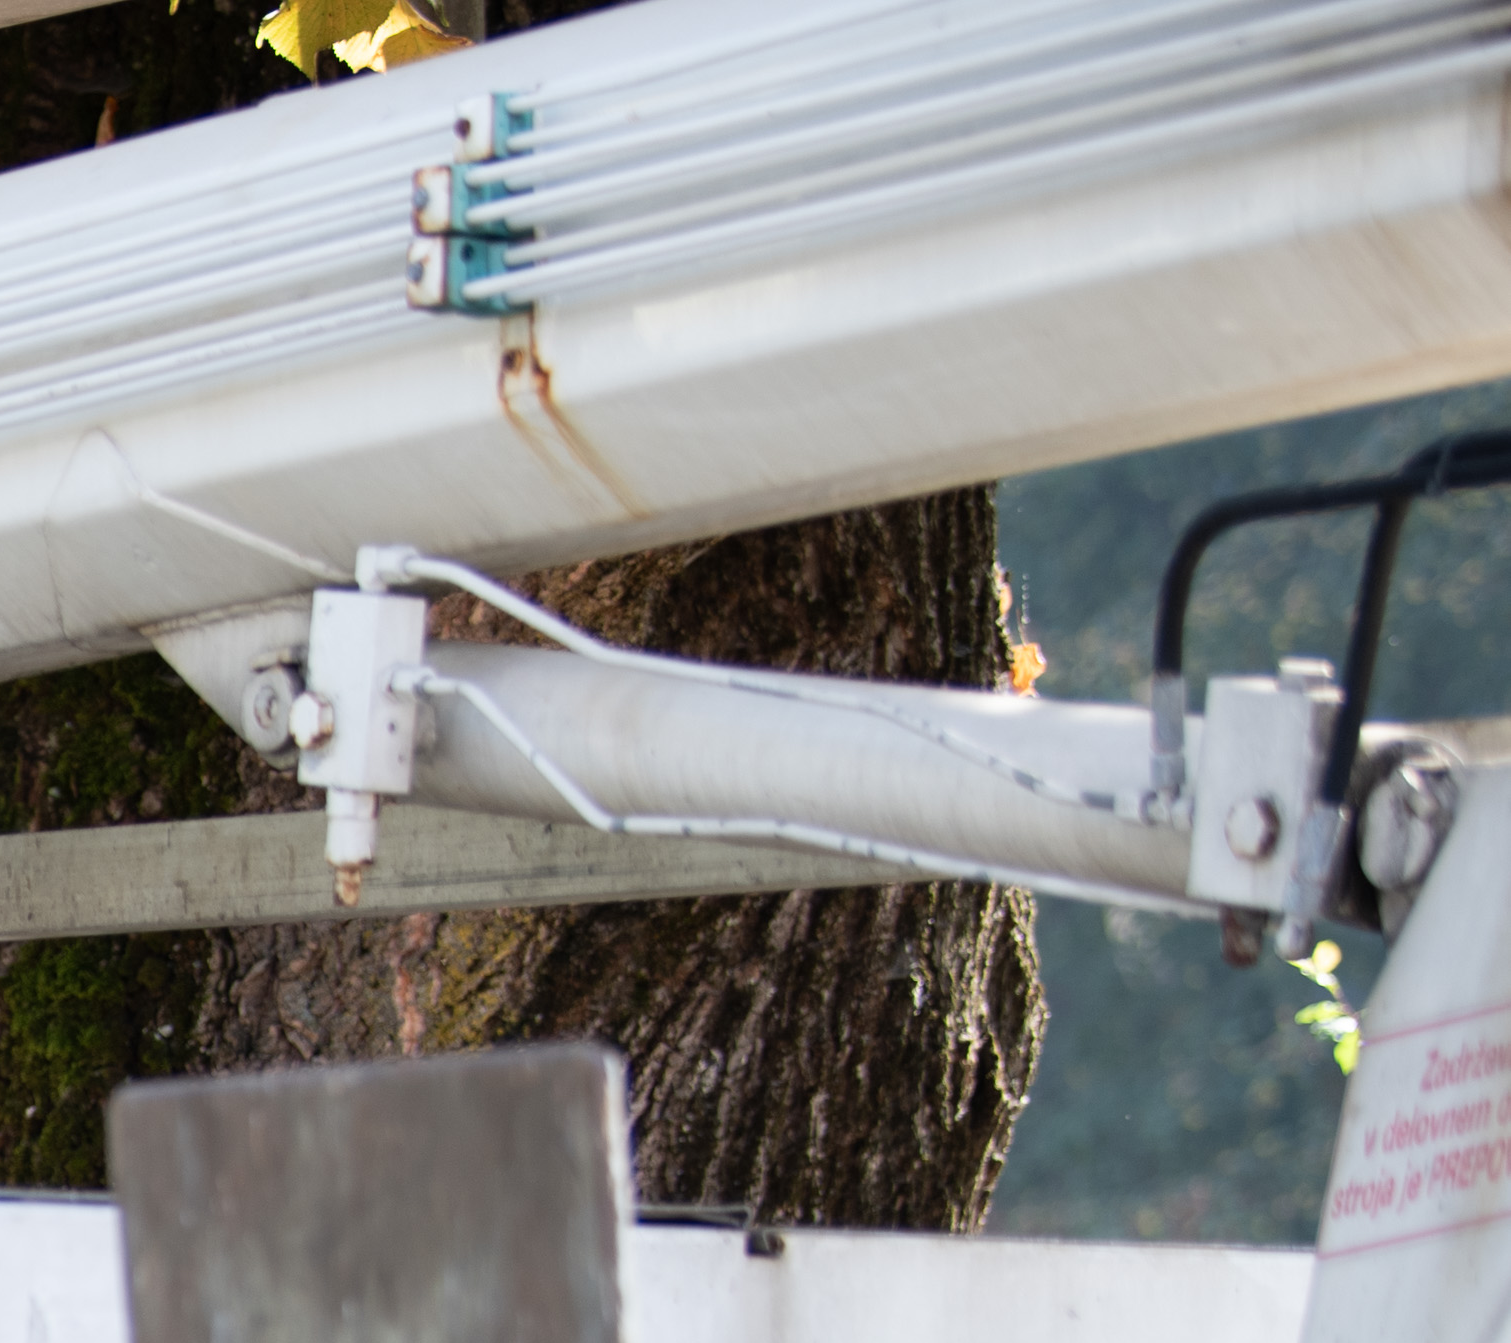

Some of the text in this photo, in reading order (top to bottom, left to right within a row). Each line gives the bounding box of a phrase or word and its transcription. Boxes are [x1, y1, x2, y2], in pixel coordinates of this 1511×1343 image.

[1364, 1124, 1378, 1159] v
[1382, 1099, 1492, 1154] delovnem
[1330, 1136, 1511, 1220] stroja je PREPO
